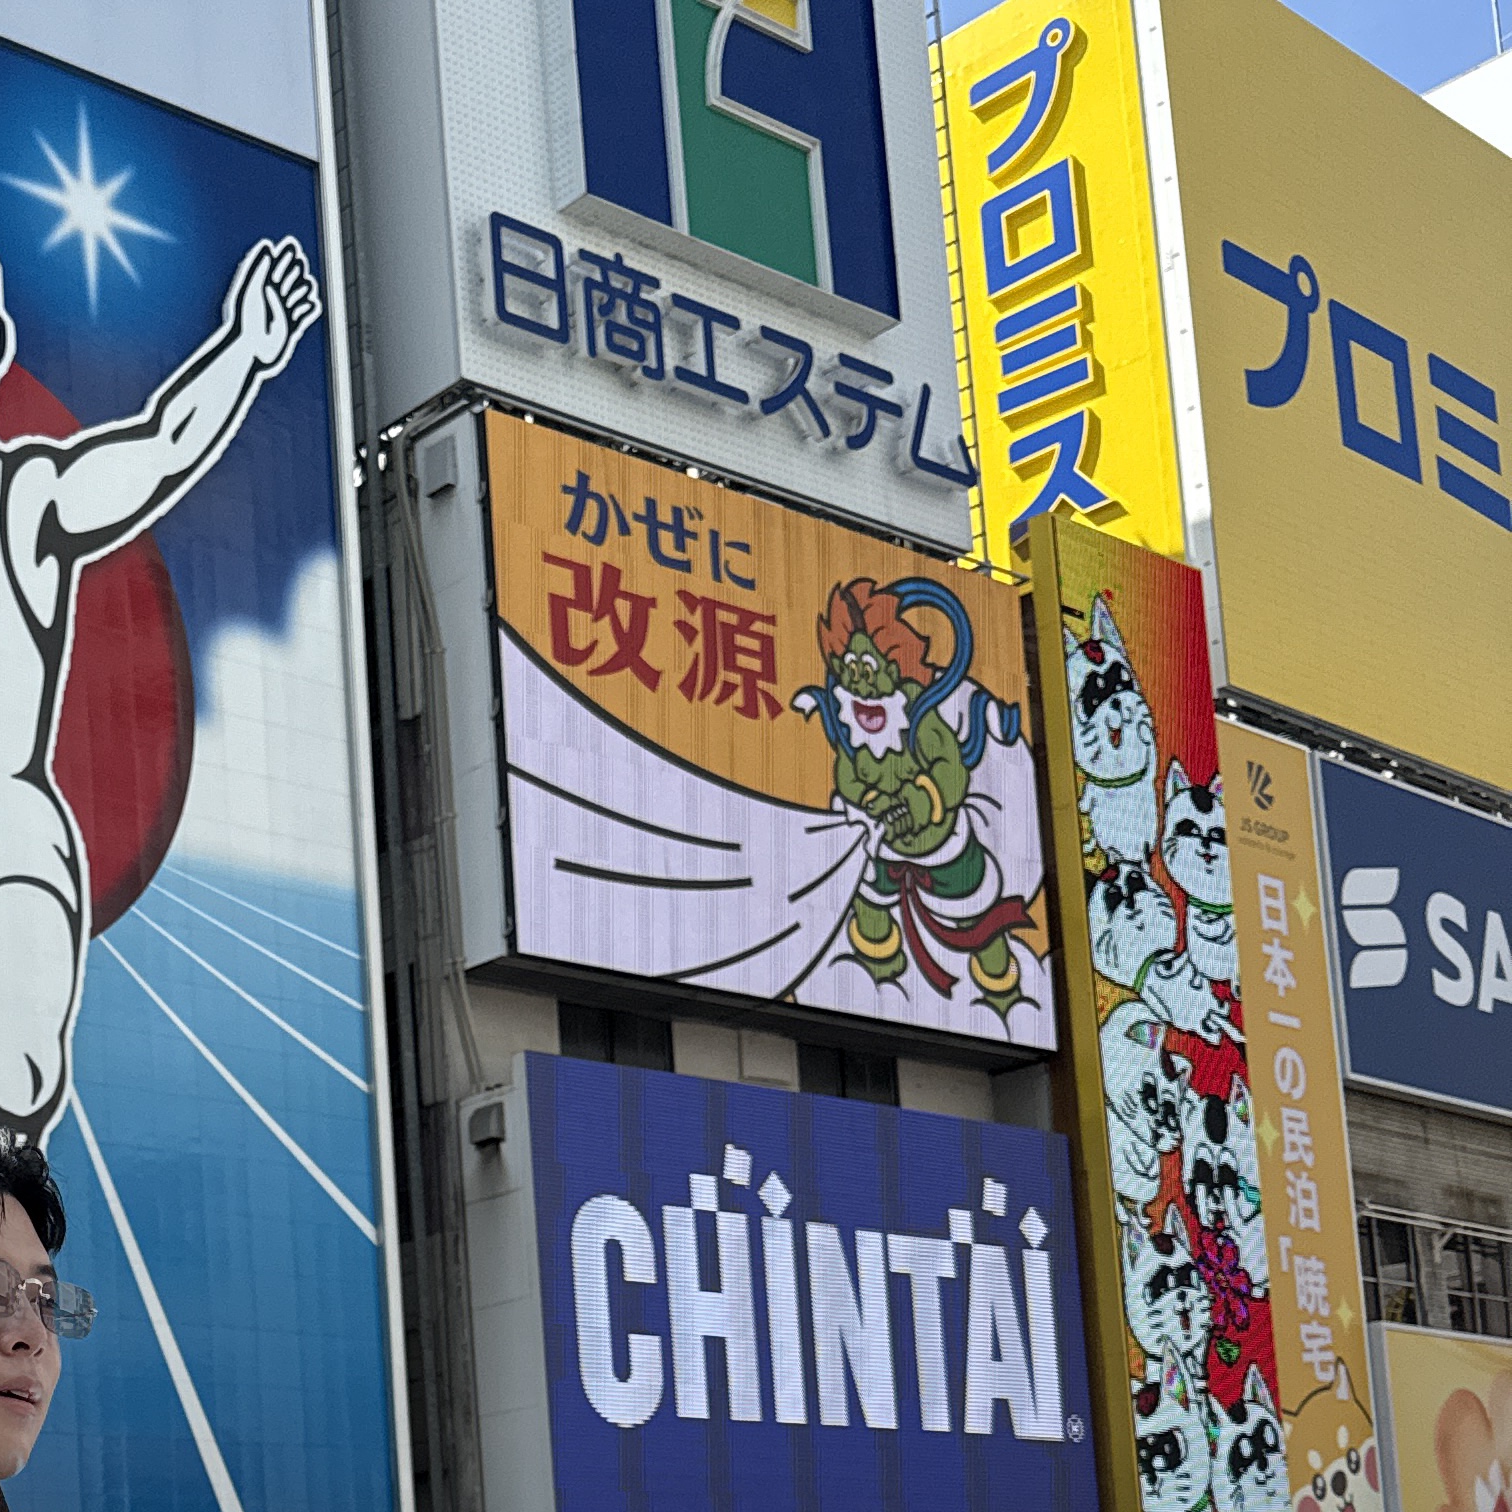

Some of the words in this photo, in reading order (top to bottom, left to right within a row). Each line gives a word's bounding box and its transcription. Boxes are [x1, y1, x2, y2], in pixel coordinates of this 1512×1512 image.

[489, 212, 978, 487] 日商エステム
[968, 16, 1114, 545] プロミス
[1221, 238, 1512, 533] プロミ
[541, 551, 785, 722] 改源
[561, 469, 757, 591] かぜに
[571, 1165, 1065, 1442] CHINTAI
